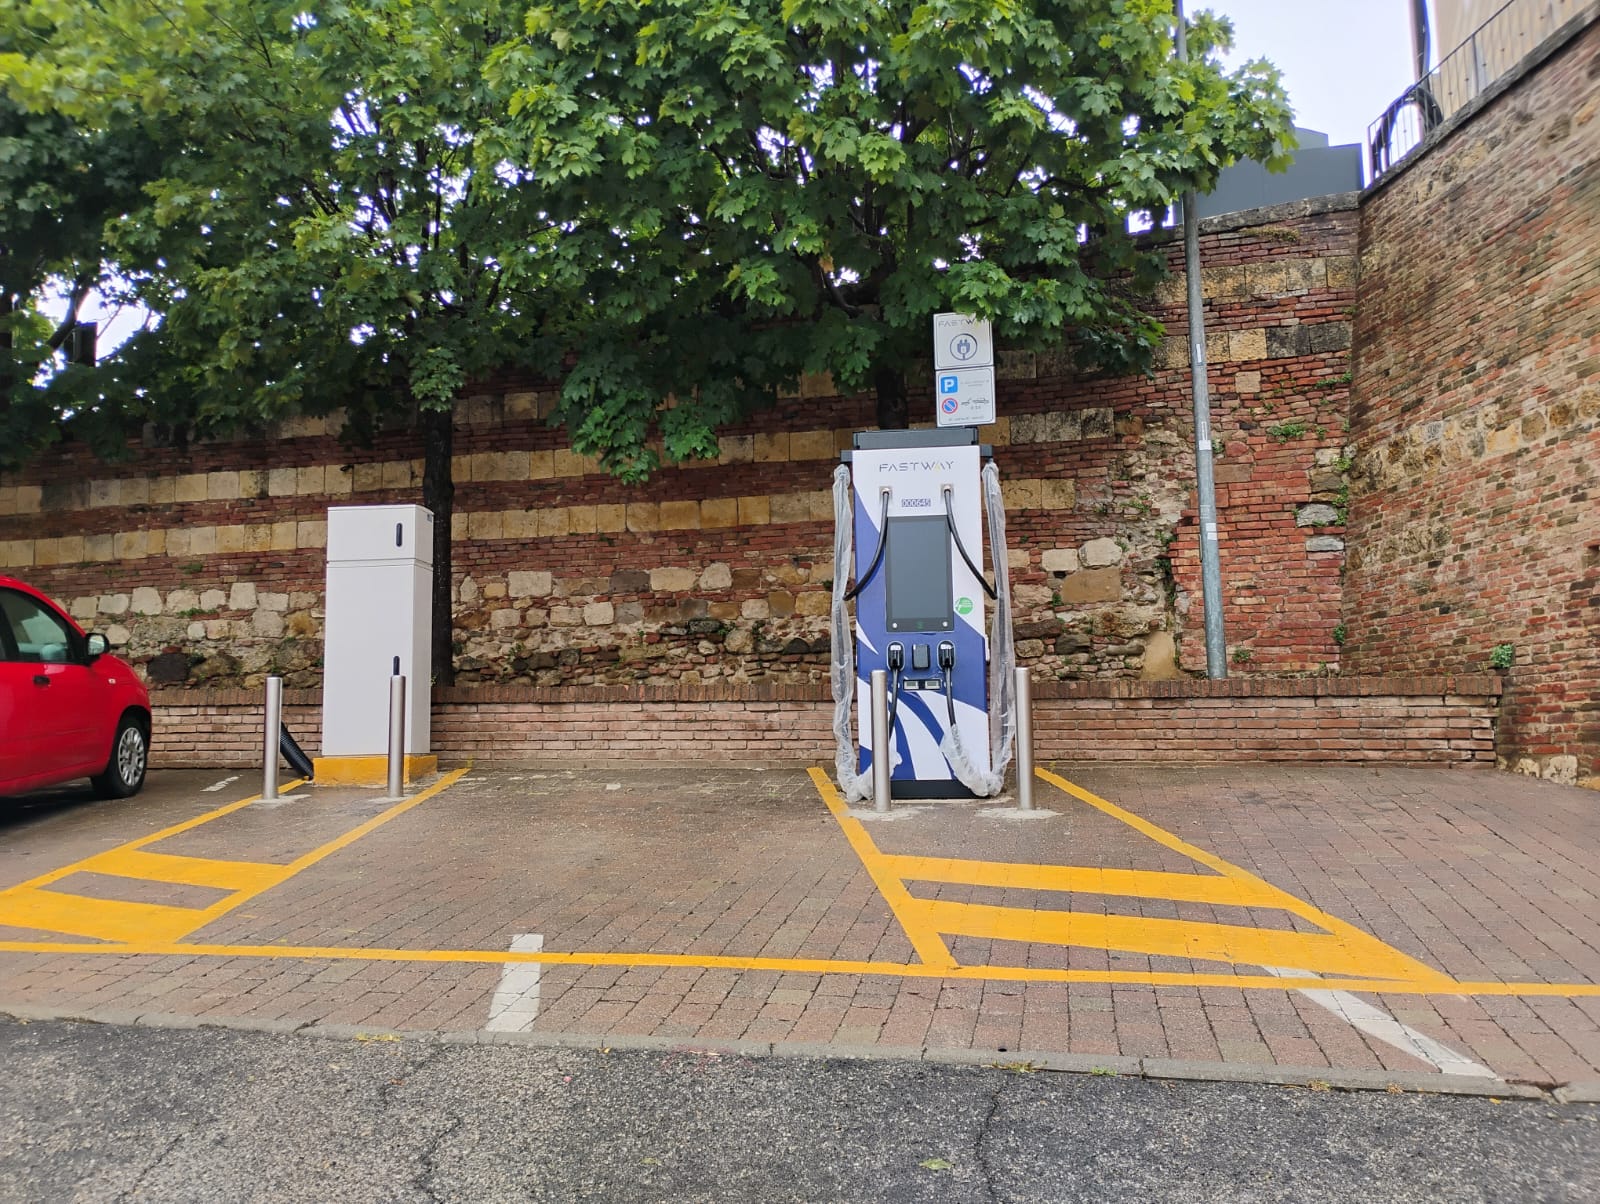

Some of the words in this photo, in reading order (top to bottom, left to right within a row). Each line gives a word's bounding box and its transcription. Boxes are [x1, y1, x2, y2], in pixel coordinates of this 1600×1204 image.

[938, 317, 986, 327] FASTW
[944, 379, 955, 392] P
[879, 461, 954, 472] FASTWAY
